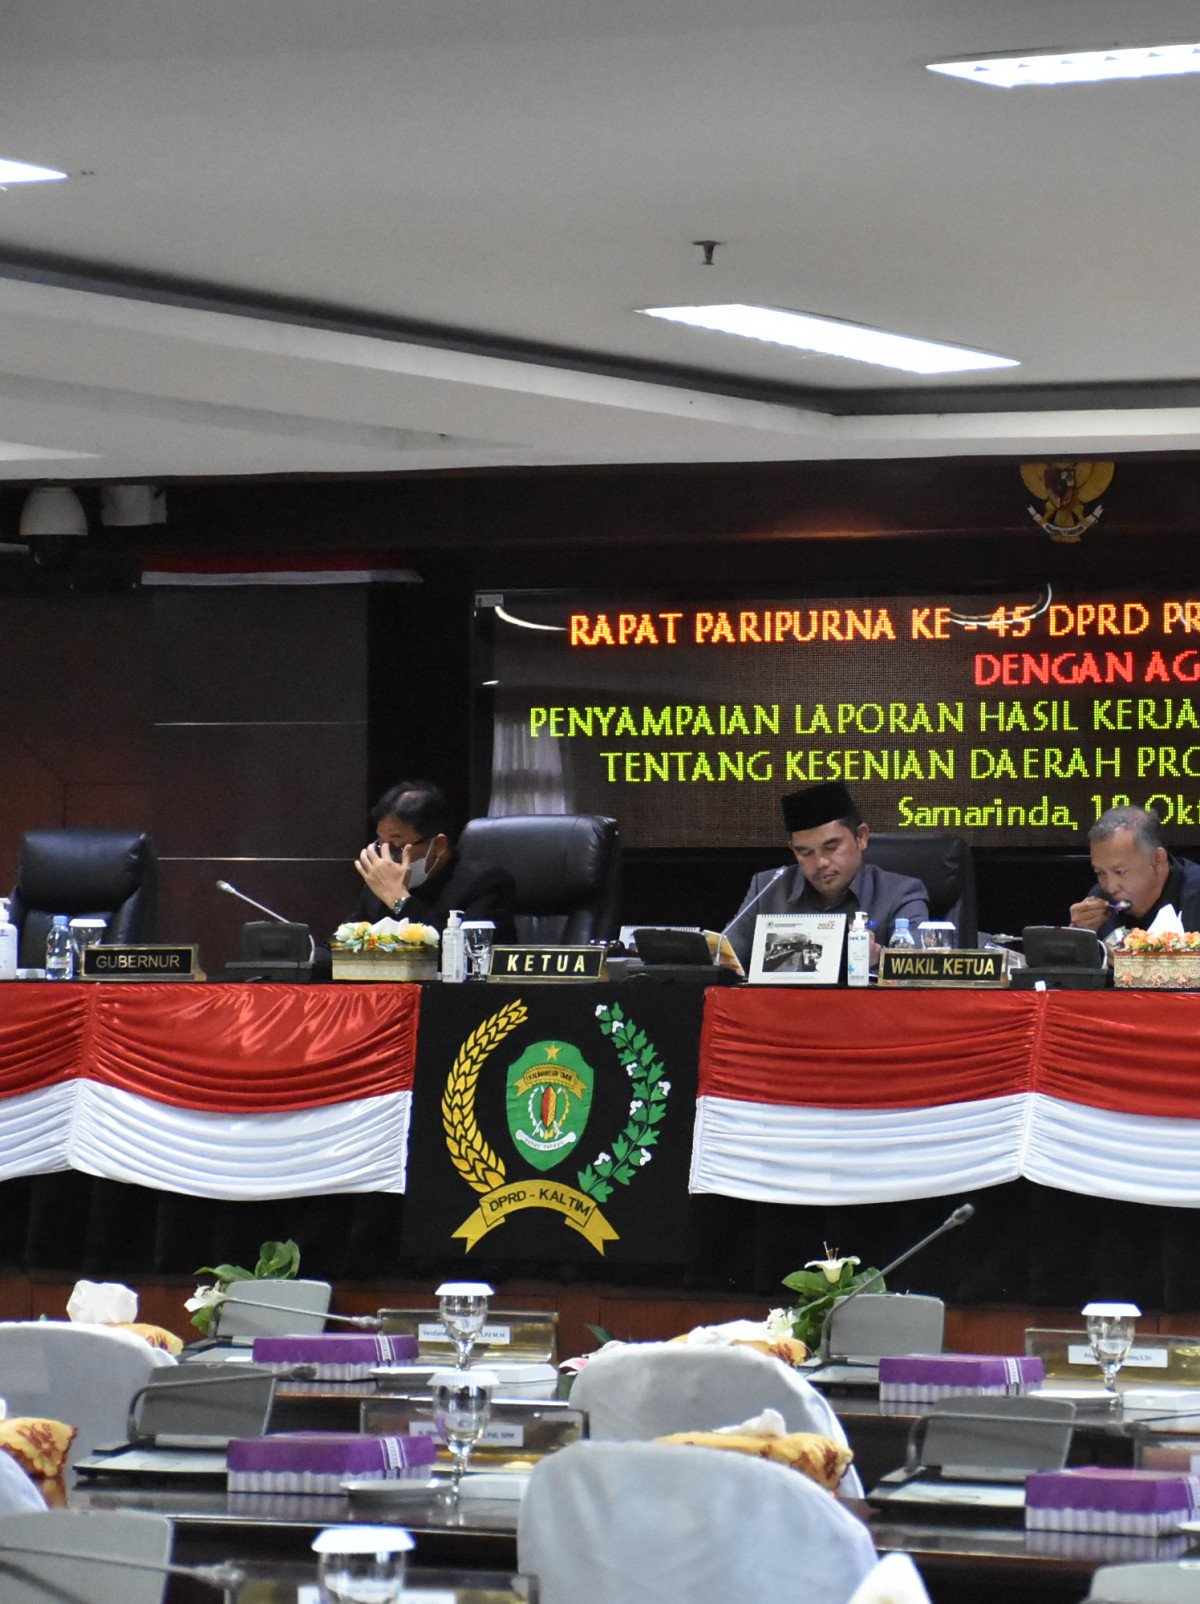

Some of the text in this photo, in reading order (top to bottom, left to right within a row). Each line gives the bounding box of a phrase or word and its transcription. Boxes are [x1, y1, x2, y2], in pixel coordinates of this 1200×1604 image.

[568, 612, 684, 647] RAPAT
[694, 605, 897, 644] PARIPURNA
[911, 606, 951, 639] KE
[986, 603, 1032, 638] 45
[1048, 602, 1150, 637] DPRD
[973, 652, 1134, 687] DENGAN
[530, 705, 780, 738] PENYAMPAIAN
[795, 702, 964, 735] LAPORAN
[980, 701, 1078, 732] HASIL
[1094, 699, 1200, 730] KERJA
[600, 751, 772, 783] TENTANG
[786, 749, 955, 781] KESENIAN
[971, 748, 1120, 779] DAERAH
[899, 796, 1079, 831] Samarinda,
[96, 955, 180, 969] GUBERNUR
[507, 954, 585, 973] KETUA
[891, 957, 995, 976] WAKIL KETUA
[489, 1190, 527, 1212] DPRD
[539, 1188, 591, 1217] KALTIM
